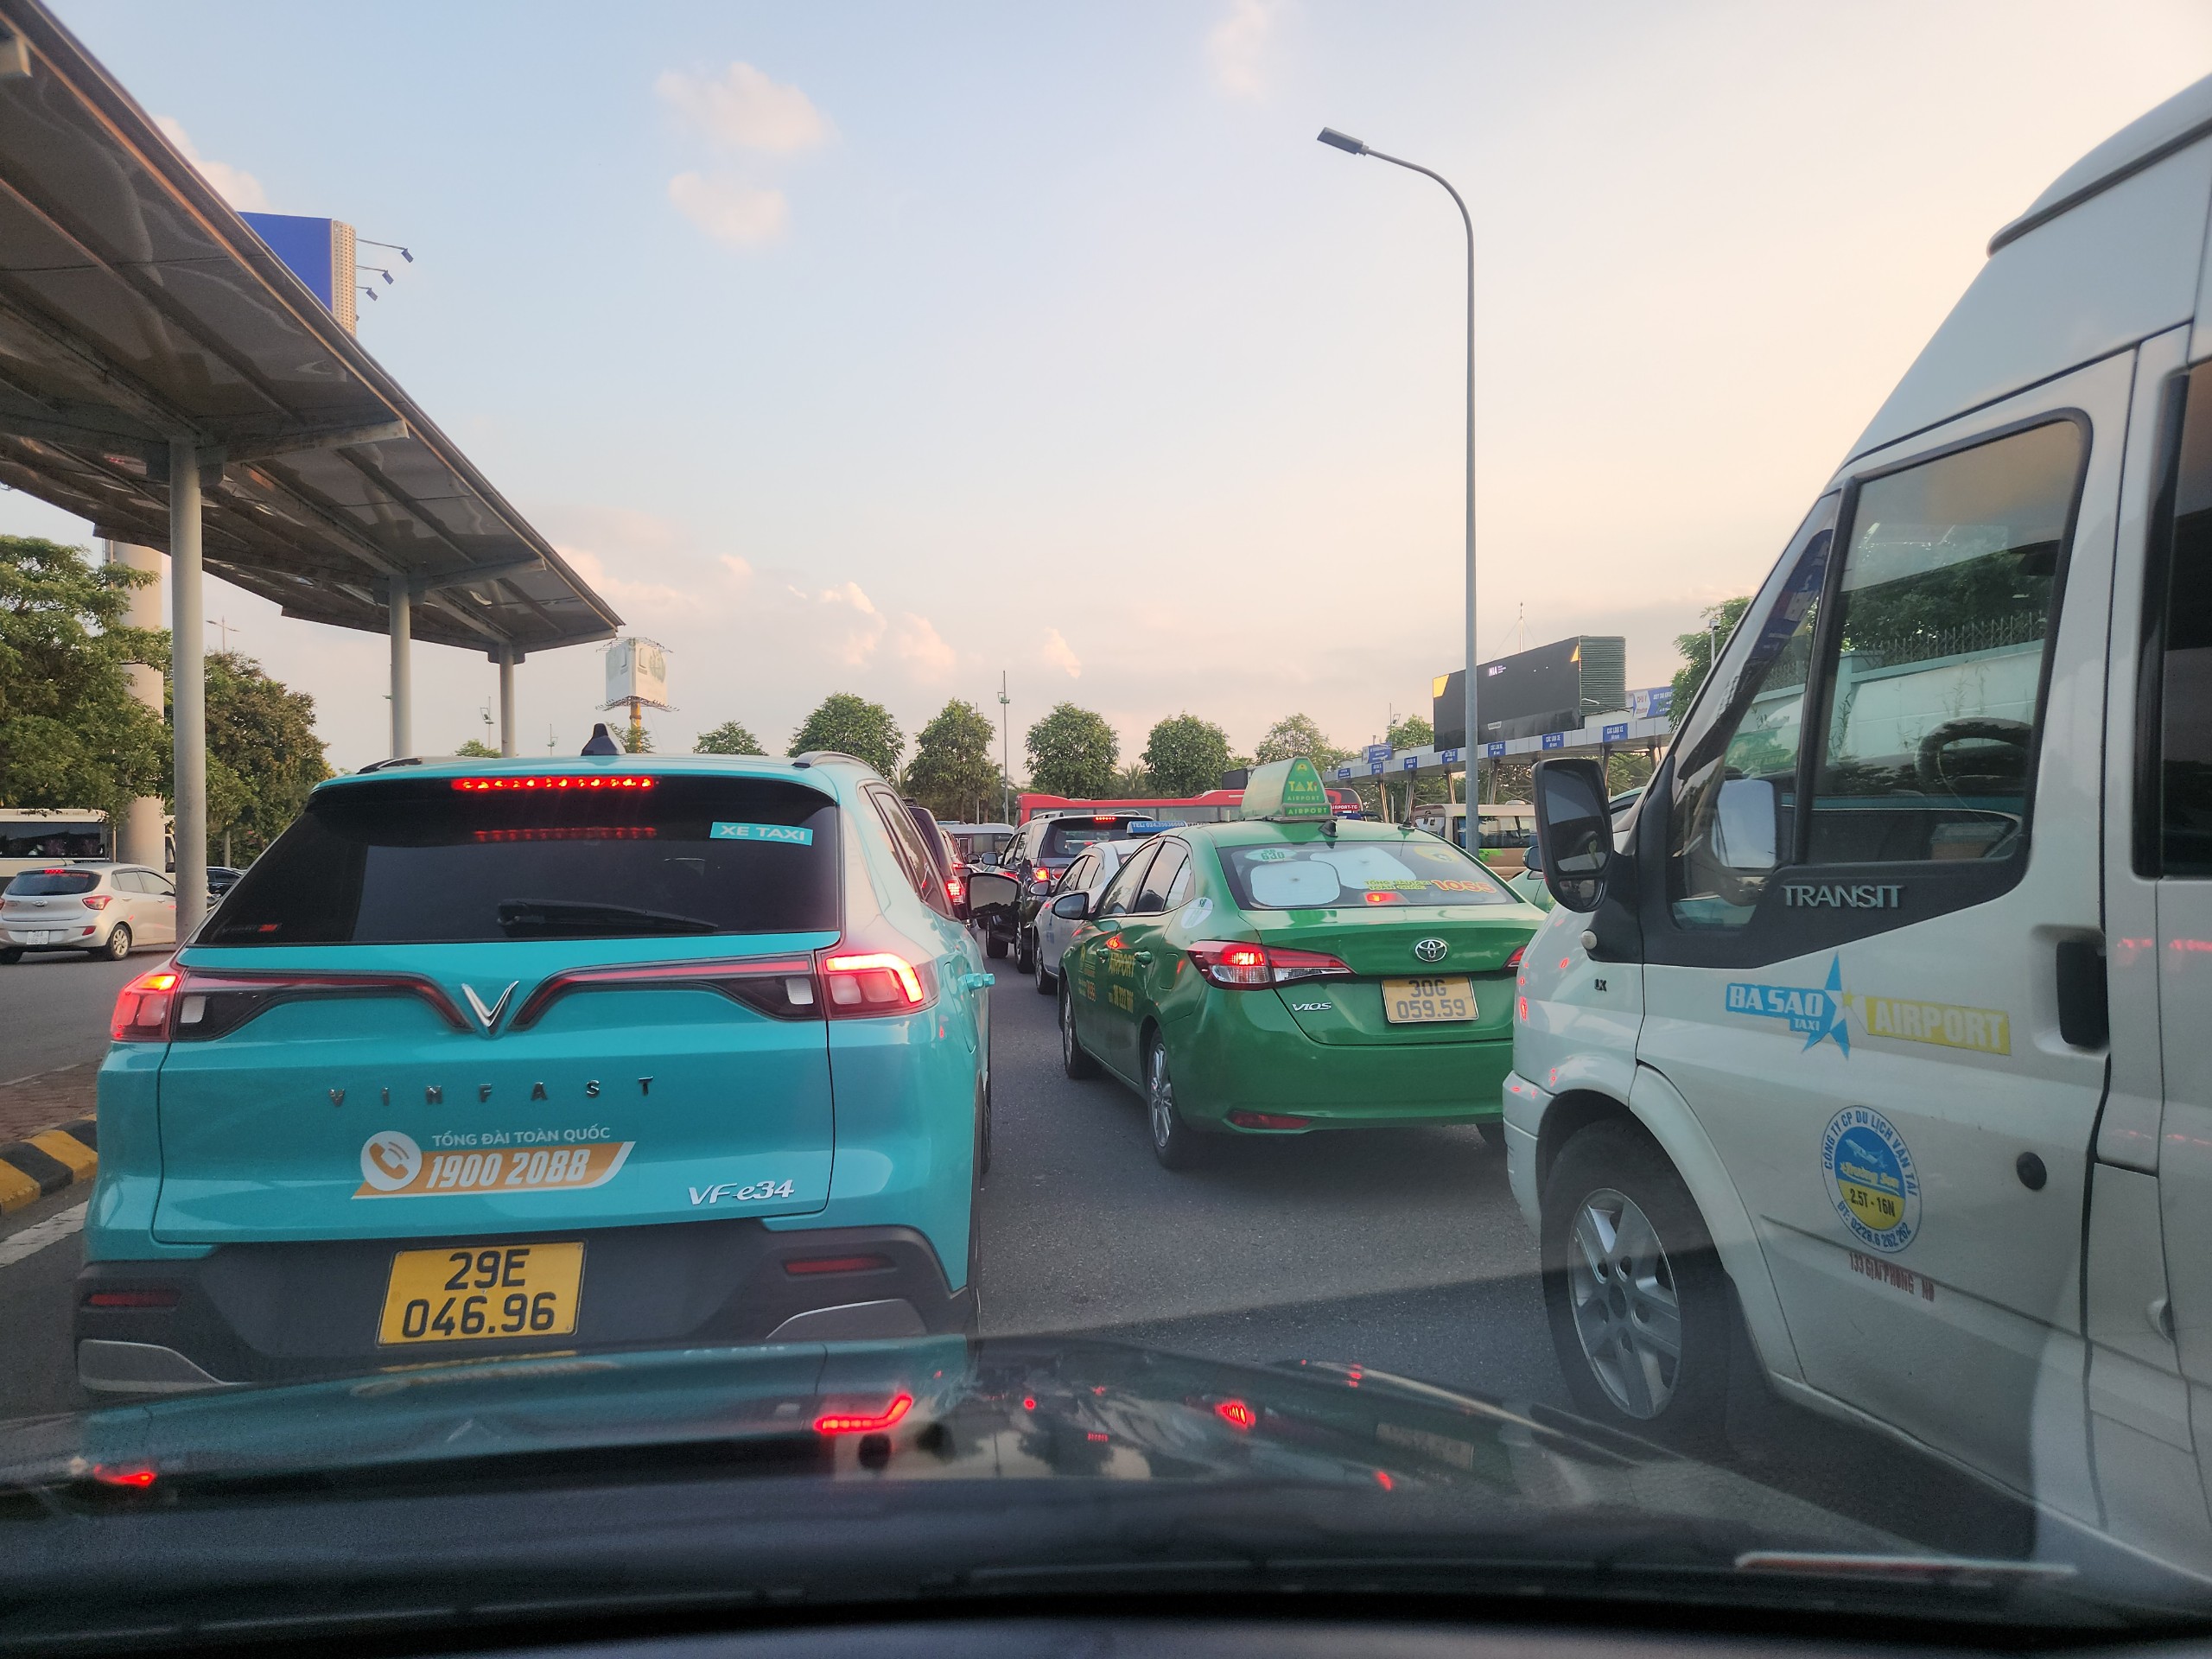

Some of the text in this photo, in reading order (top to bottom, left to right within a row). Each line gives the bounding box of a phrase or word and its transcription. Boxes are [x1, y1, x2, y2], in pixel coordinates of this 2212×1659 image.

[721, 825, 804, 841] XE TAXI
[1431, 880, 1497, 893] 1055
[1782, 885, 1903, 907] TRANSIT
[1408, 979, 1447, 998] 30G
[1291, 1001, 1332, 1011] VIOS
[1396, 999, 1466, 1020] 059.59
[1729, 986, 1824, 1017] BA SAO
[1793, 1018, 1821, 1032] TAXI
[1874, 1002, 2005, 1049] AIRPORT
[328, 1075, 654, 1107] VINFAST
[481, 1130, 510, 1145] ĐÀI
[514, 1128, 559, 1143] TOÀN
[563, 1124, 610, 1142] QUỐC
[1823, 1135, 1835, 1170] CÔNG
[1831, 1120, 1842, 1136] TY
[1841, 1111, 1853, 1127] CP
[1856, 1110, 1868, 1124] DU
[1872, 1115, 1893, 1141] LỊCH
[426, 1149, 591, 1188] 1900 2088
[689, 1183, 737, 1205] VF
[1850, 1188, 1868, 1208] 2.5T
[1877, 1197, 1896, 1217] 16N
[444, 1249, 531, 1291] 29E
[402, 1292, 557, 1338] 046.96
